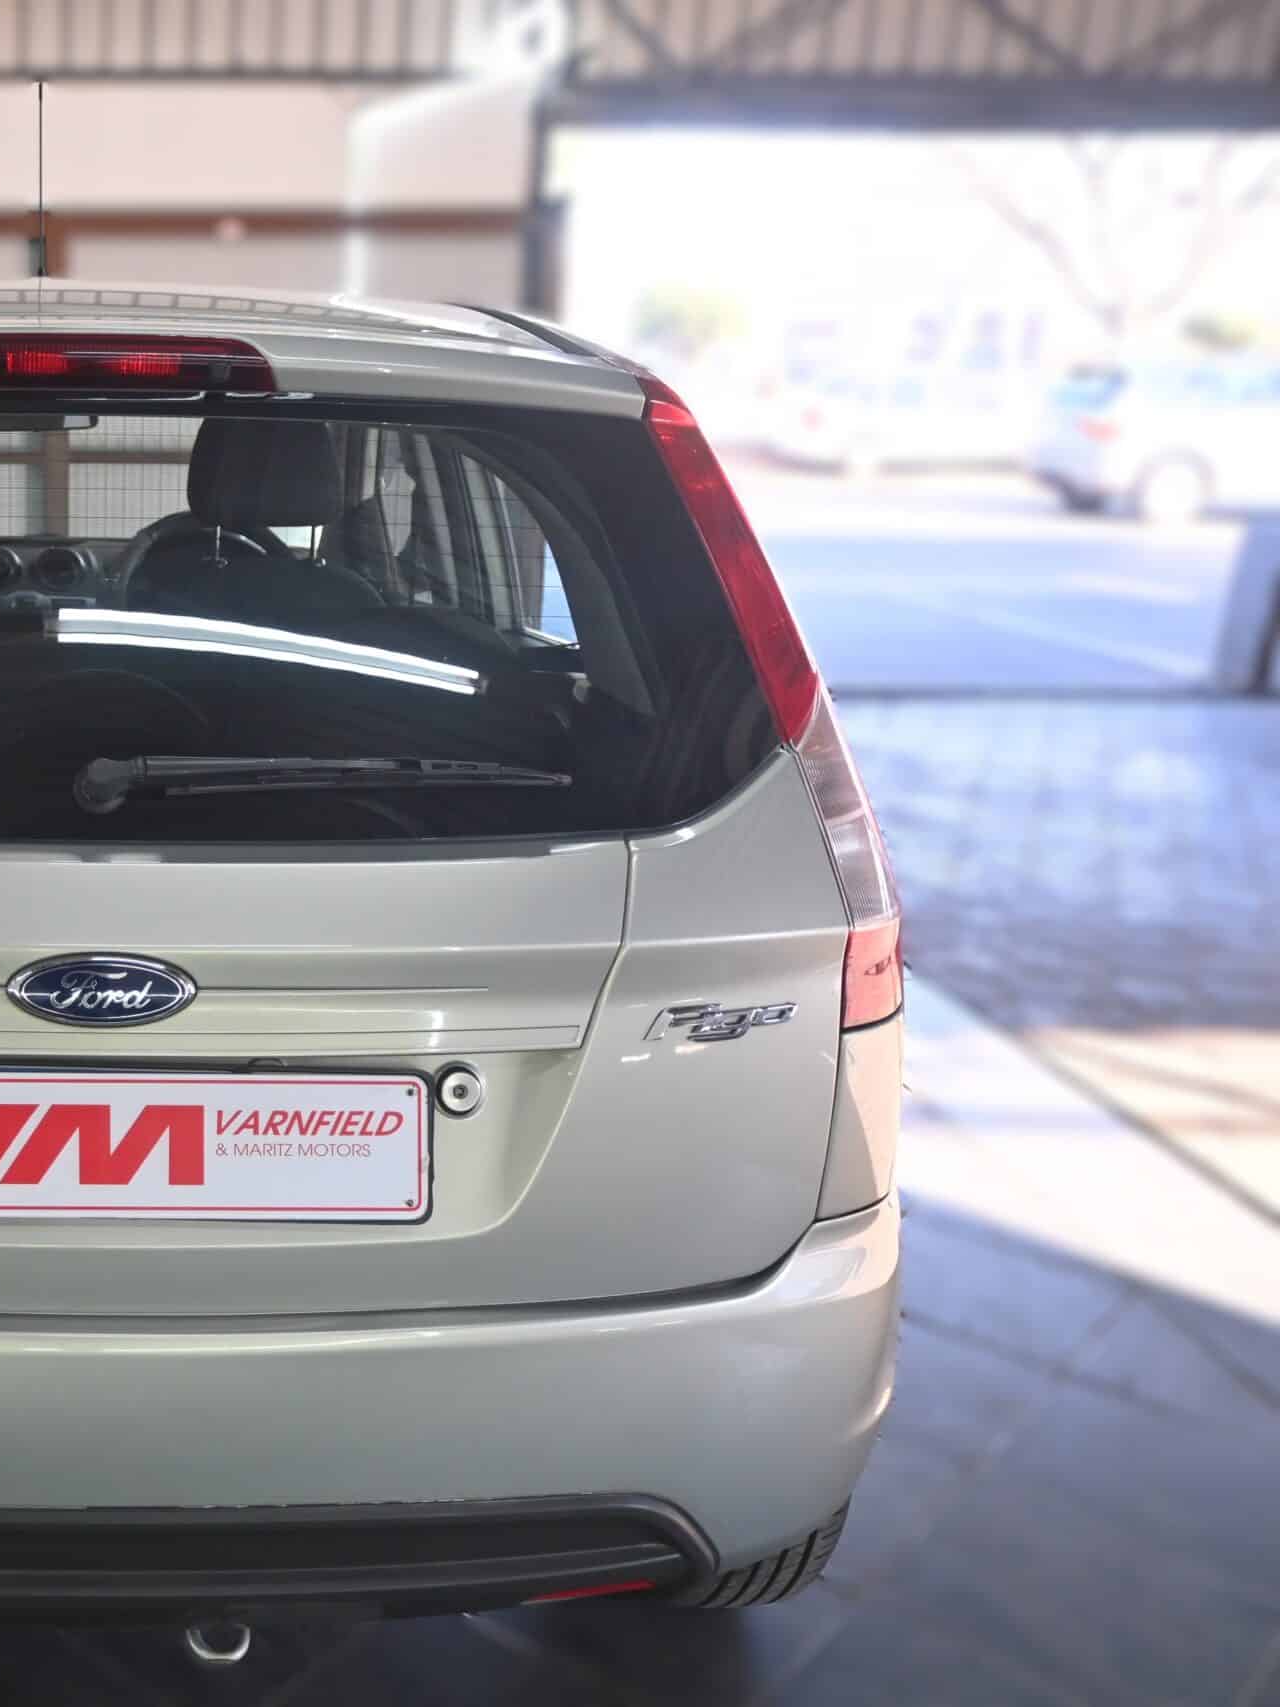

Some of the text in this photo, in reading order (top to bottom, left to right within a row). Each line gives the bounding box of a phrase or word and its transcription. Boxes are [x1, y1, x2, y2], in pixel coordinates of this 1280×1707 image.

[49, 970, 152, 1009] Ford
[216, 1110, 404, 1136] VARNFIELD
[215, 1143, 372, 1158] & MARITZ MOTORS
